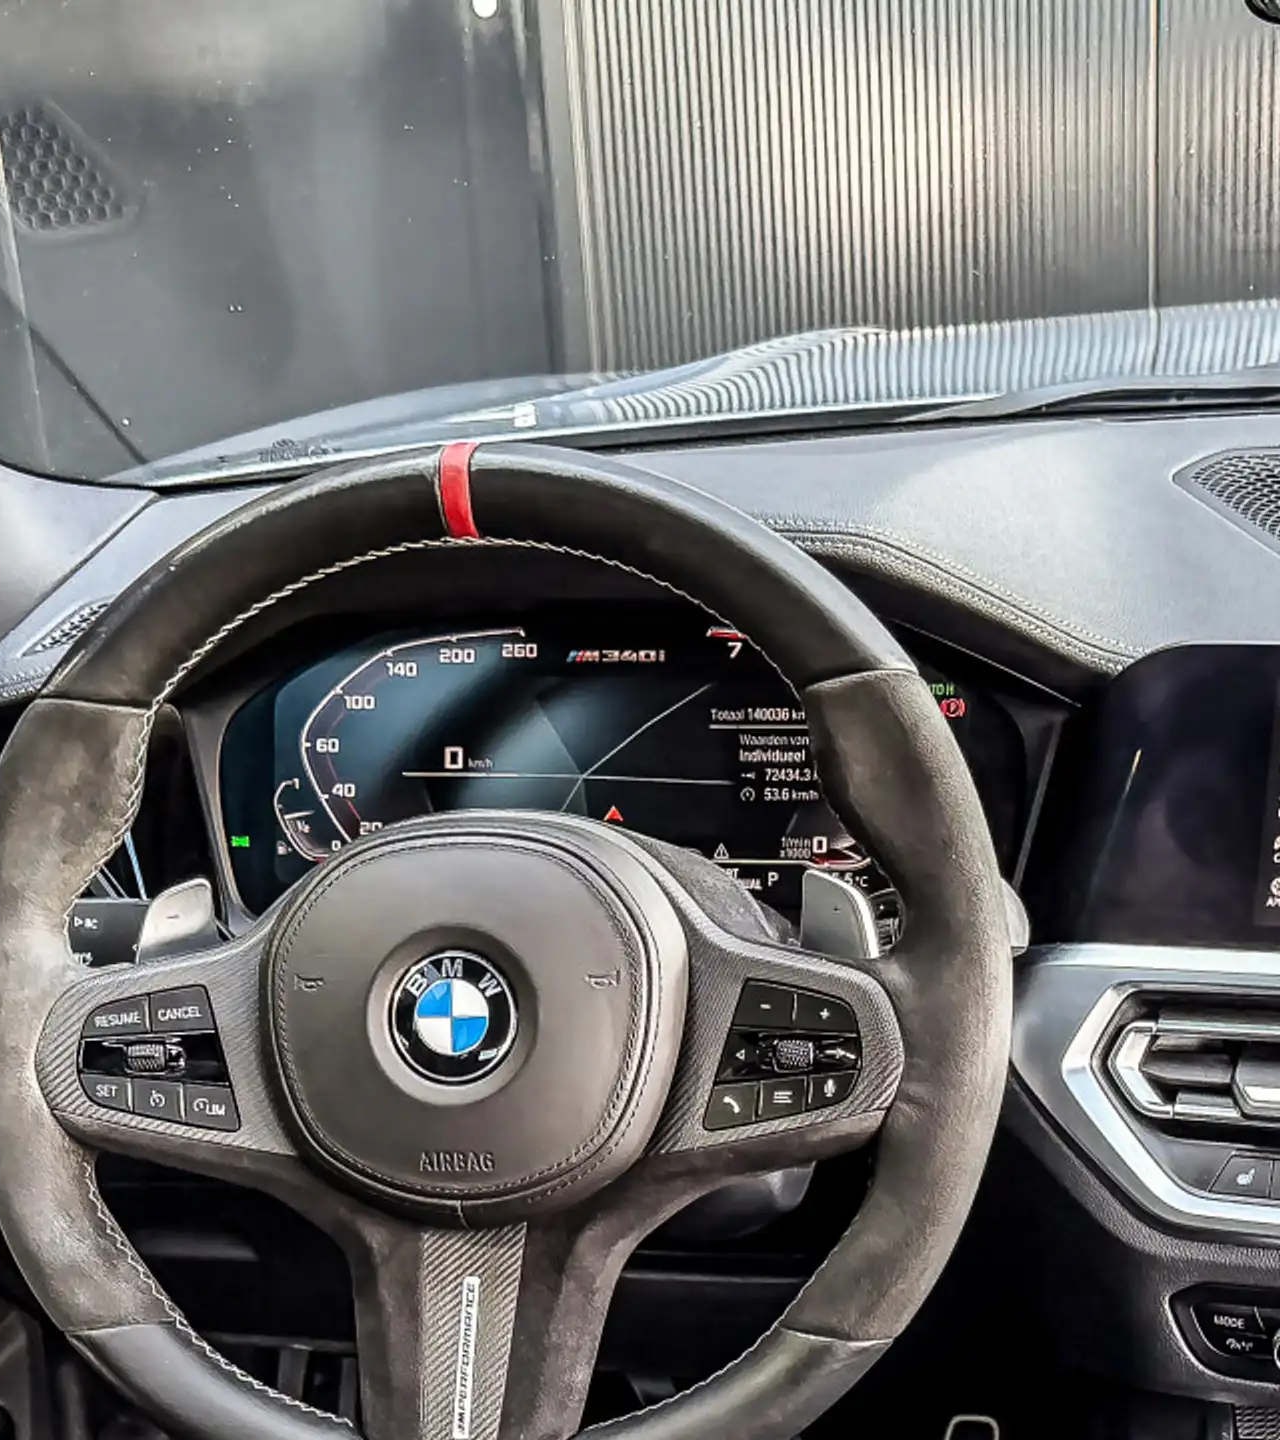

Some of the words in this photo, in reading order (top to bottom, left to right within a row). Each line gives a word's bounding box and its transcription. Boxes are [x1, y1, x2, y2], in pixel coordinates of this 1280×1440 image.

[439, 649, 475, 663] 200
[502, 644, 537, 658] 260
[728, 642, 742, 658] 7
[386, 662, 417, 676] 140
[344, 696, 375, 709] 100
[711, 709, 745, 720] Totaal
[747, 708, 789, 721] 140036
[316, 738, 339, 752] 60
[739, 734, 788, 746] Waarden
[790, 736, 809, 746] van
[444, 747, 464, 769] 0
[468, 757, 493, 768] km/h
[739, 749, 806, 762] Individueel
[764, 768, 811, 781] 72434.3
[331, 783, 355, 797] 40
[764, 788, 789, 801] 53.6
[792, 790, 819, 801] km/h
[331, 841, 341, 851] 0
[812, 836, 827, 853] 0
[768, 872, 779, 886] P
[405, 958, 503, 998] BMW
[95, 1011, 141, 1027] RESUME
[158, 1006, 202, 1021] CANCEL
[96, 1084, 118, 1097] SET
[420, 1152, 494, 1172] AIRBAG
[1214, 1315, 1245, 1329] MODE
